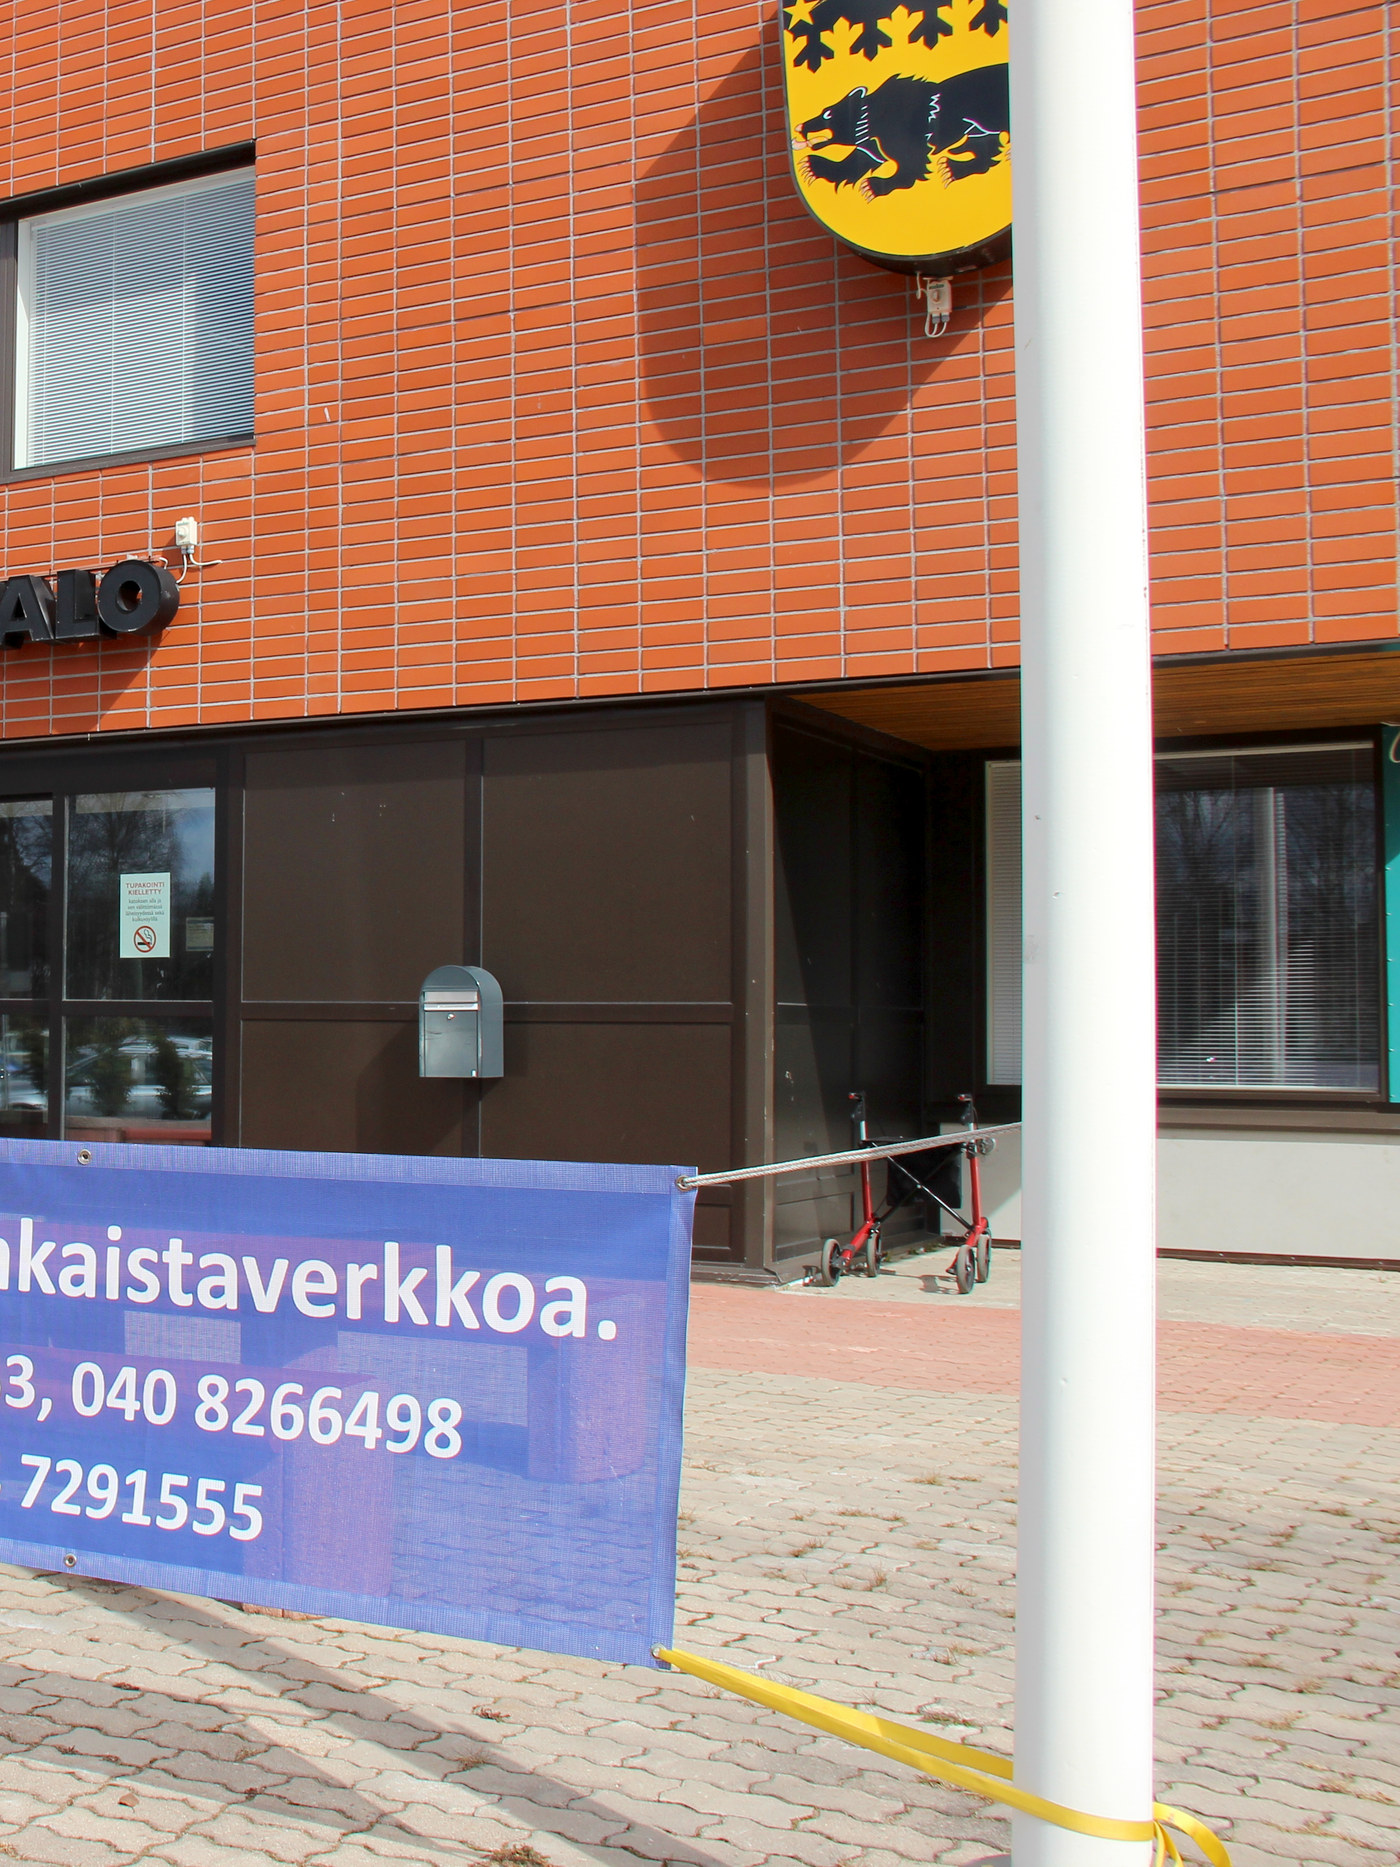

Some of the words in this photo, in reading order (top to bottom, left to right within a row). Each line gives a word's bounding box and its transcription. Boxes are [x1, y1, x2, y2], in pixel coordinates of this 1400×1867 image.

[125, 881, 165, 889] TUPAKOINTI
[128, 888, 162, 896] KIELLETTY
[71, 1362, 177, 1425] 040
[194, 1374, 464, 1459] 8266498
[20, 1454, 264, 1541] 7291555
